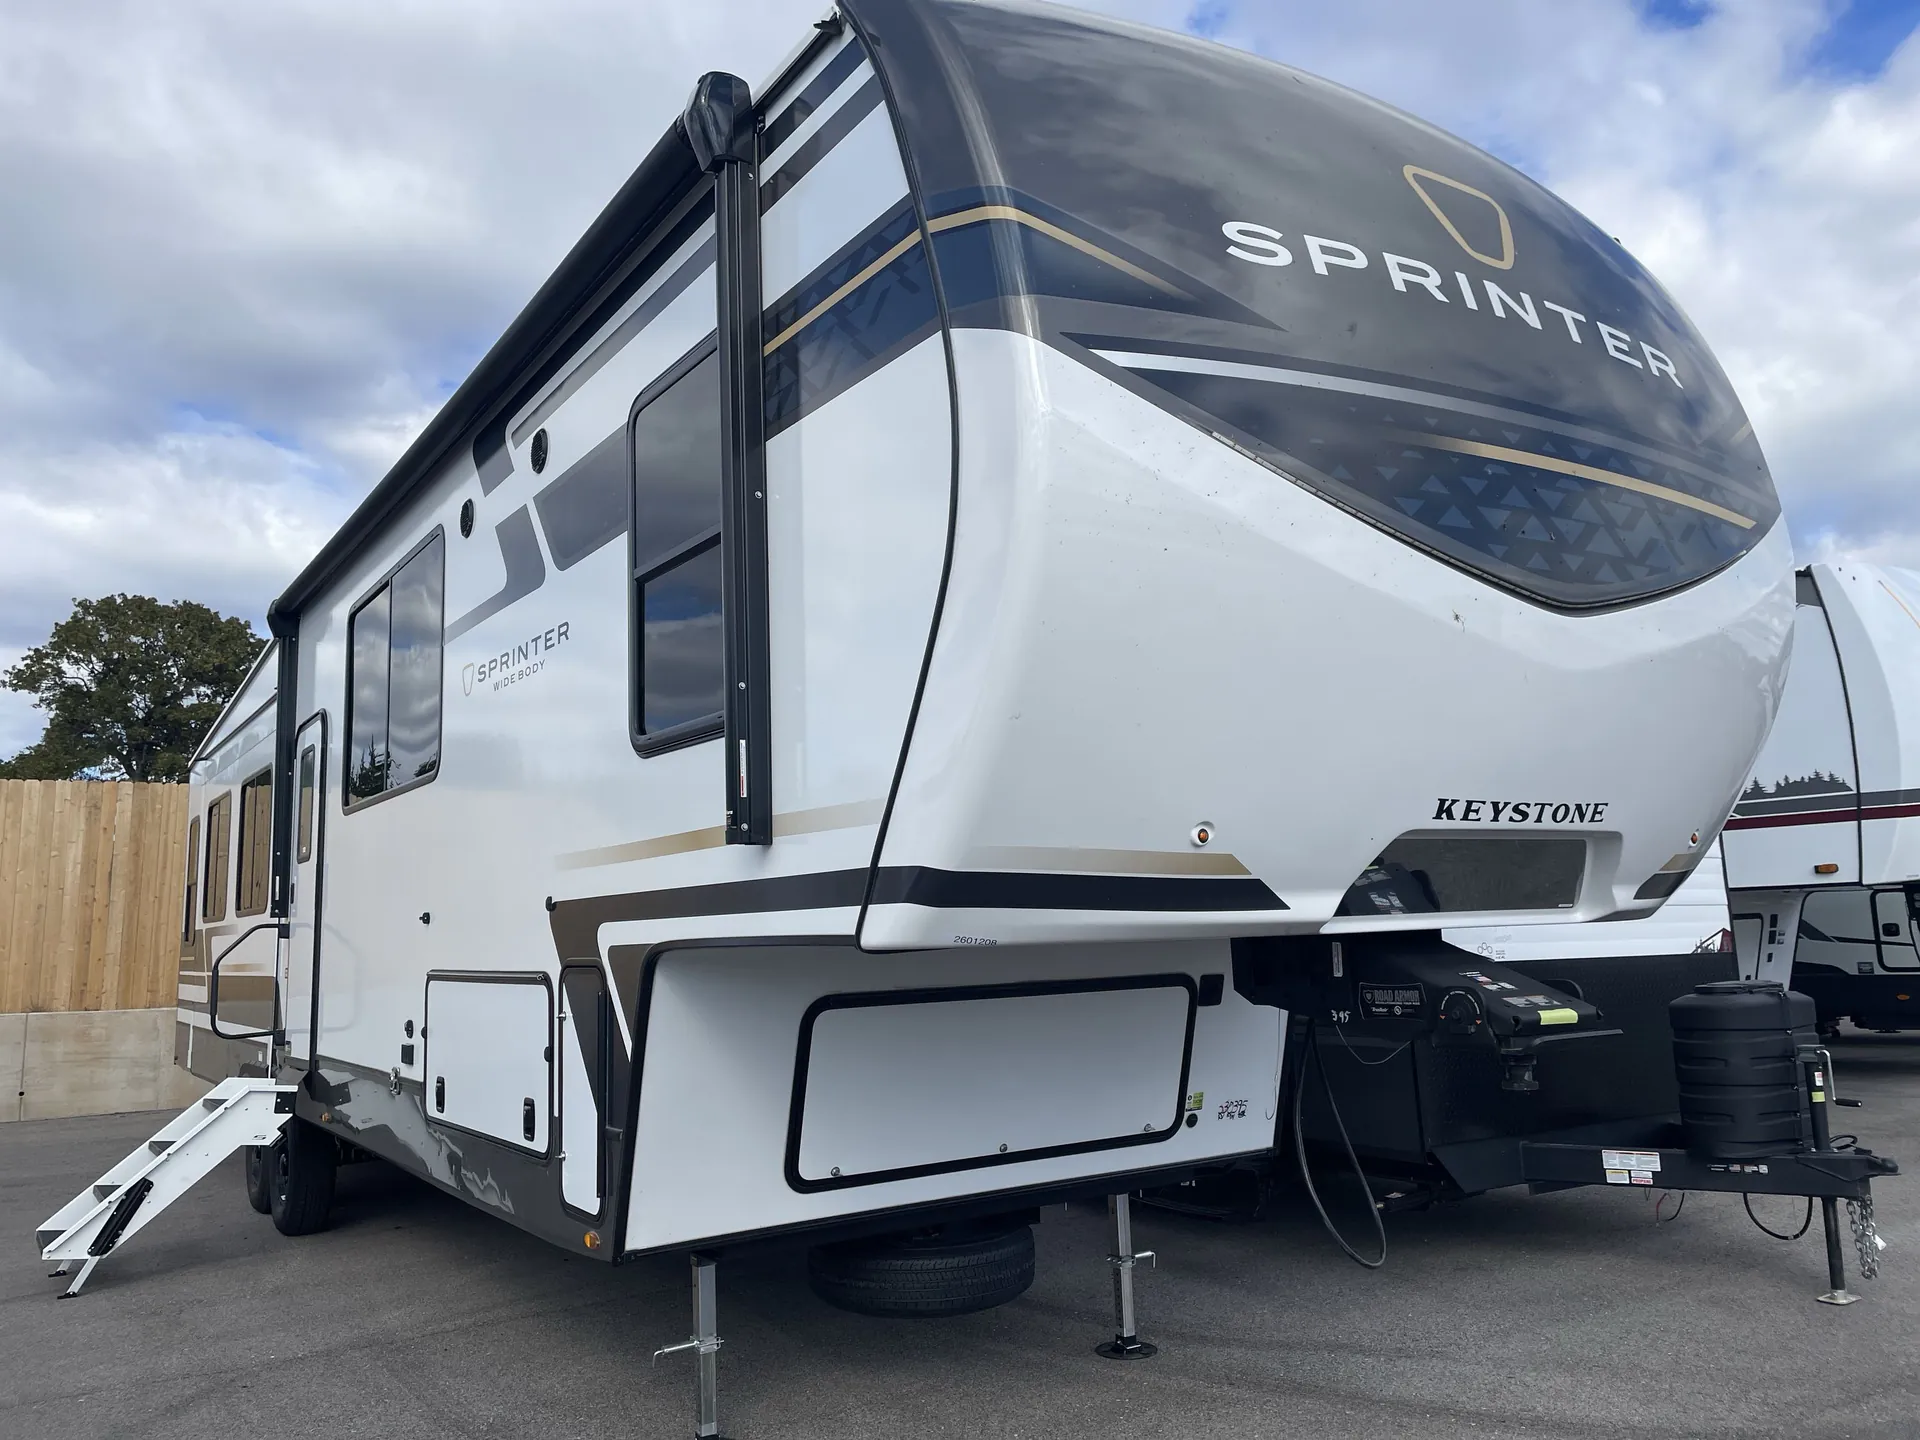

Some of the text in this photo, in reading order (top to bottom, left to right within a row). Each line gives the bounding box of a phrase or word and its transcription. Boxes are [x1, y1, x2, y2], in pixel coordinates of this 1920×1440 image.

[1221, 221, 1684, 389] SPRINTER
[477, 621, 570, 683] SPRINTER
[493, 659, 546, 692] WIDE BODY
[1432, 798, 1609, 824] KEYSTONE
[1374, 989, 1420, 1003] ROAD ARMOR
